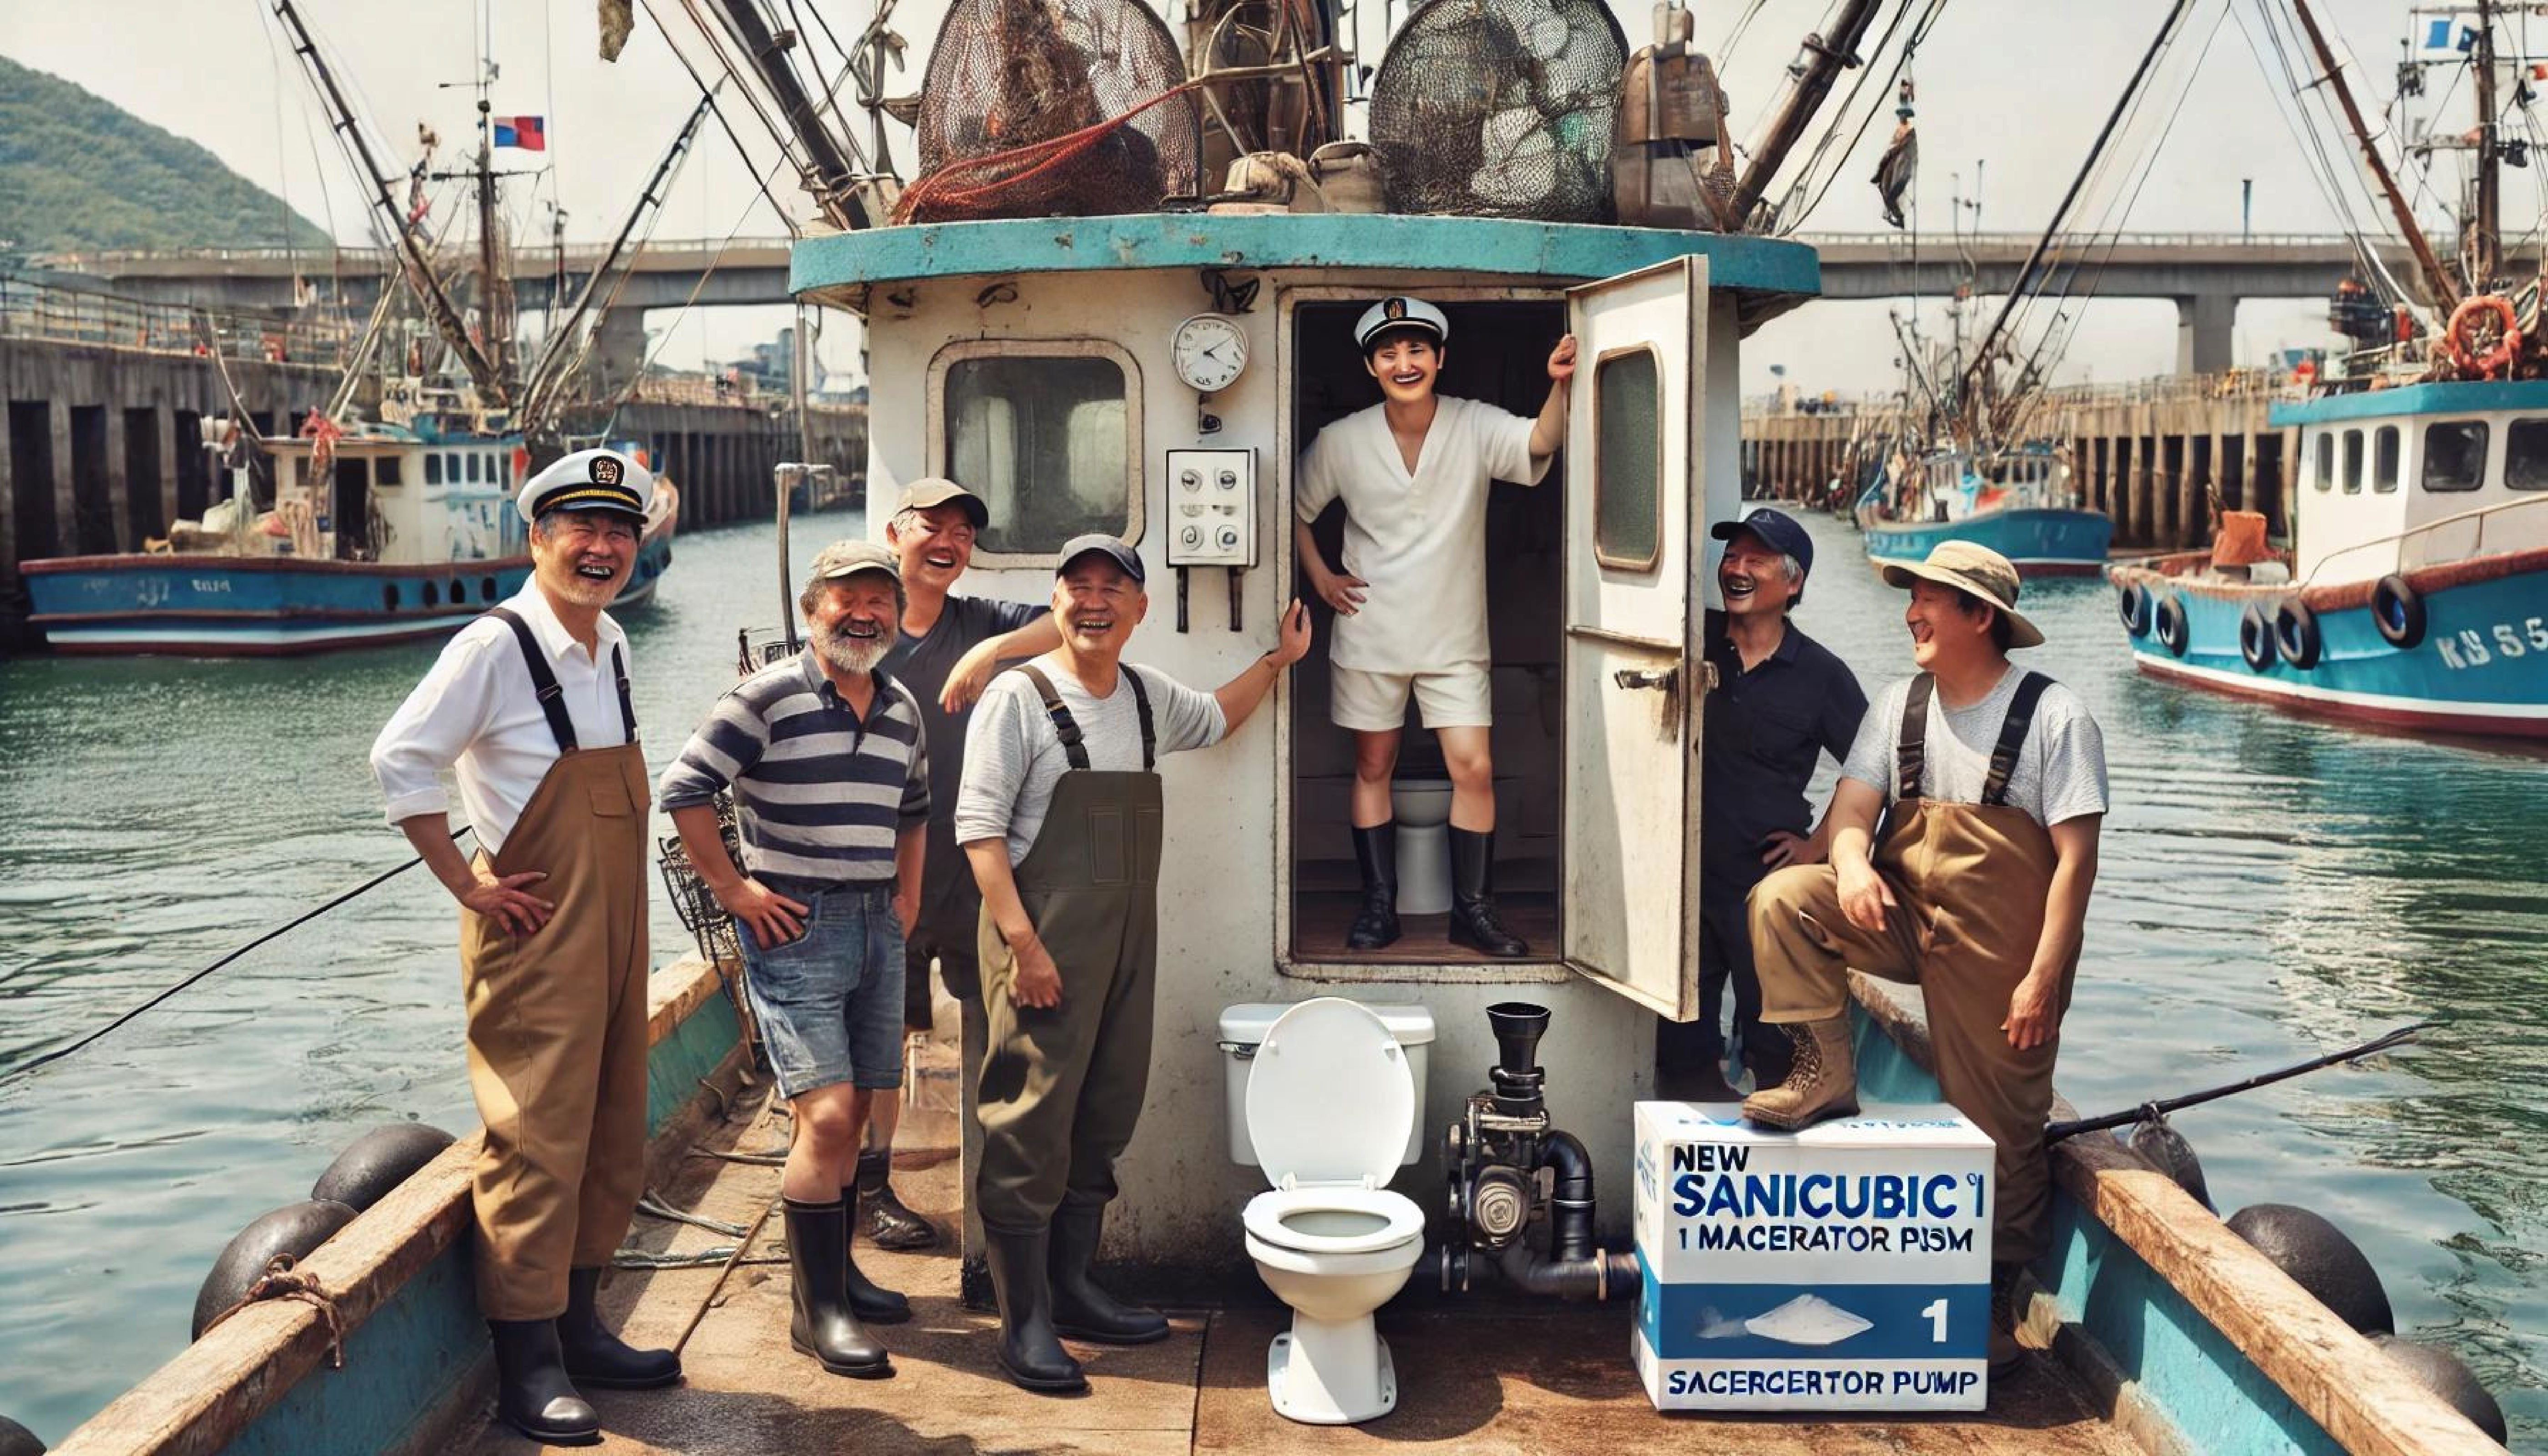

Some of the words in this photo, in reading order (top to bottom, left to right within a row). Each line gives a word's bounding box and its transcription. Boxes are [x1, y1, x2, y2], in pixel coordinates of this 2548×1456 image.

[1673, 1145, 1749, 1172] NEW
[1673, 1174, 1958, 1218] SANICUBIC
[1699, 1224, 1891, 1252] MACERATOR
[1922, 1299, 1948, 1343] 1
[1894, 1370, 1979, 1395] PUMP
